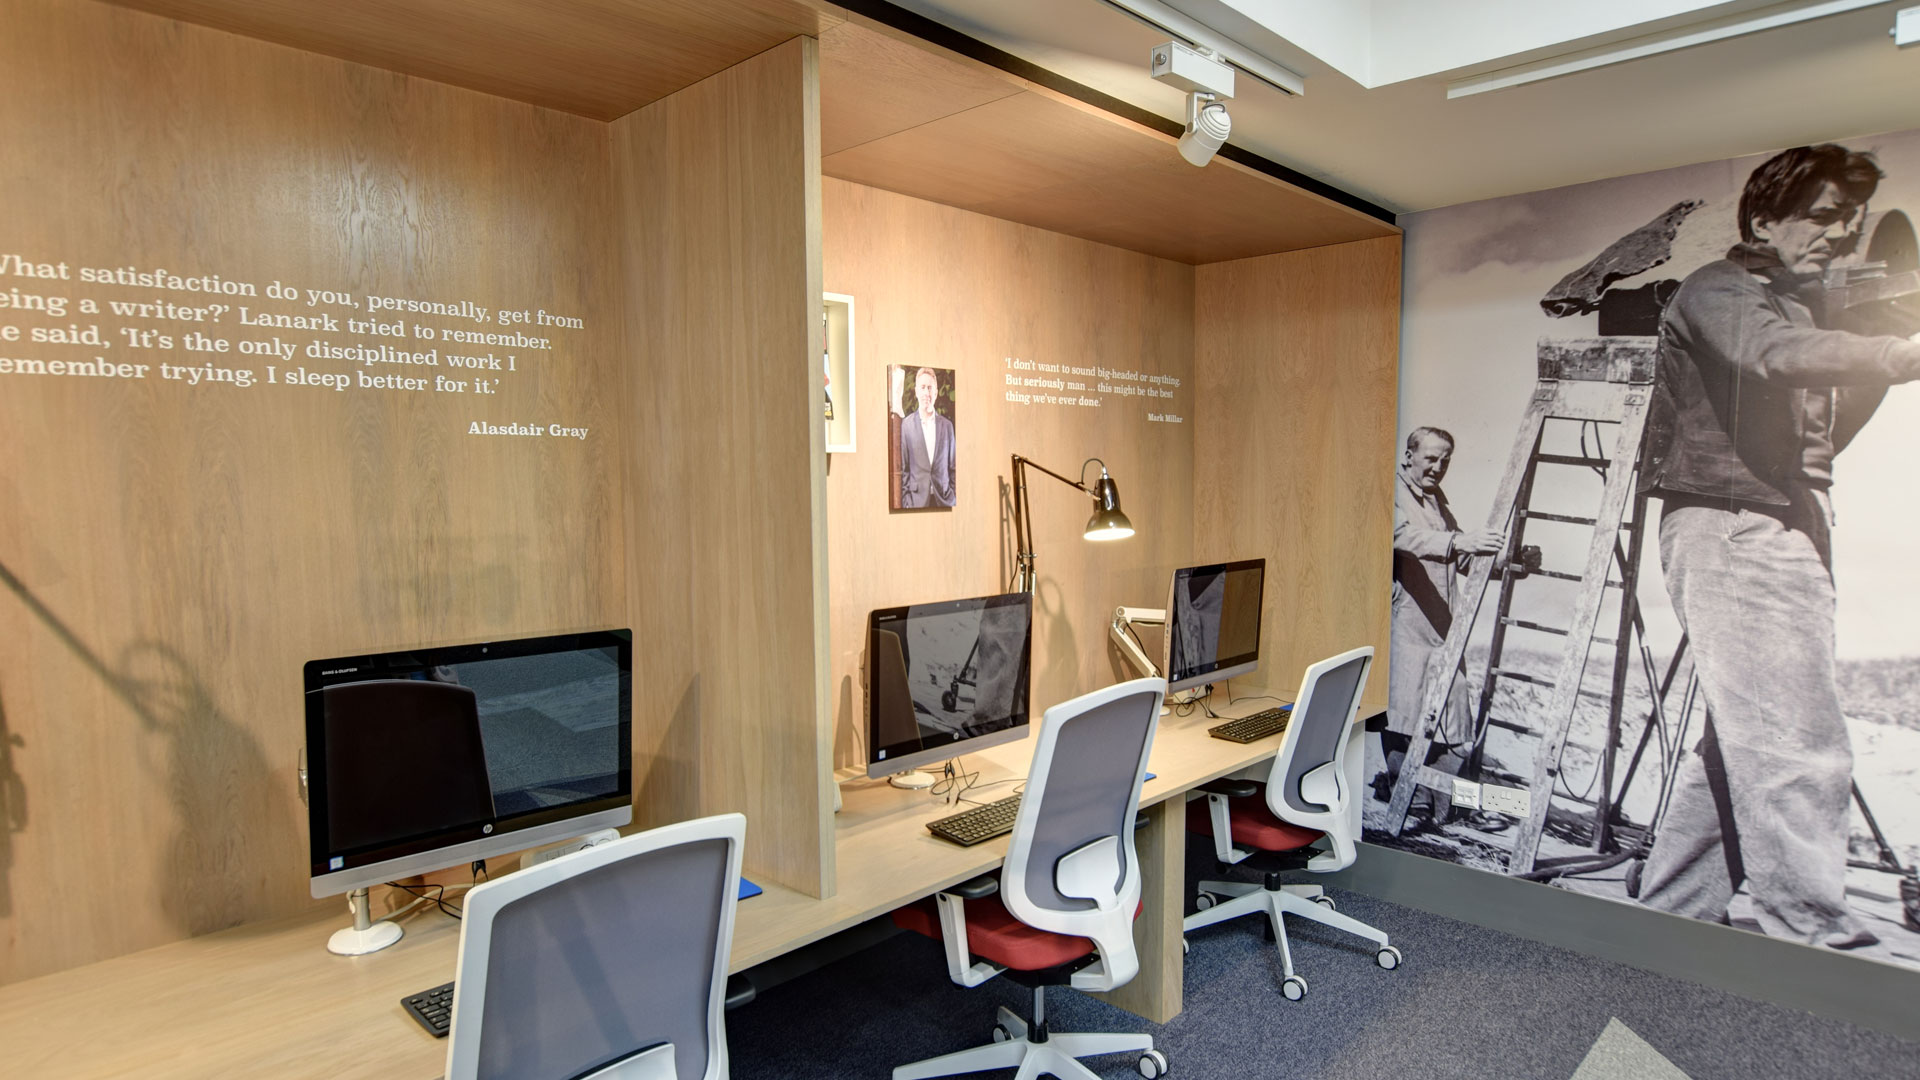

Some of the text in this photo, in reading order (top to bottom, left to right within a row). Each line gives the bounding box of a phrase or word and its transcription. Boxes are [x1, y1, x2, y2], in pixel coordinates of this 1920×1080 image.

[79, 265, 258, 297] satisfaction
[265, 280, 299, 301] do
[306, 289, 360, 309] you,
[366, 295, 491, 323] personally,
[497, 309, 532, 326] get
[536, 309, 585, 330] from
[79, 298, 100, 314] a
[108, 299, 230, 323] writer?'
[239, 306, 340, 332] Lanark
[347, 317, 406, 338] tried
[413, 323, 435, 340] to
[441, 329, 552, 350] remember.
[0, 324, 516, 372] e said, 'It's the only disciplined work I
[159, 362, 258, 388] trying.
[266, 365, 277, 384] I
[285, 368, 351, 392] sleep
[356, 370, 429, 391] better
[434, 374, 468, 393] for
[474, 377, 500, 395] it.'
[1014, 358, 1035, 371] don't
[1038, 363, 1059, 373] want
[1062, 365, 1070, 375] to
[1072, 366, 1095, 377] sound
[1097, 366, 1139, 380] big-headed
[1140, 374, 1148, 382] or
[1005, 374, 1021, 386] But
[1023, 376, 1065, 392] seriously
[1067, 382, 1085, 391] man
[1098, 382, 1112, 393] this
[1114, 385, 1135, 397] might
[1137, 386, 1145, 397] be
[1147, 387, 1158, 398] the
[1160, 388, 1173, 399] best
[1006, 391, 1030, 406] thing
[1033, 393, 1056, 405] we've
[1059, 397, 1077, 406] ever
[467, 421, 589, 441] Alasdair Gray
[1148, 413, 1184, 424] Mark Millar
